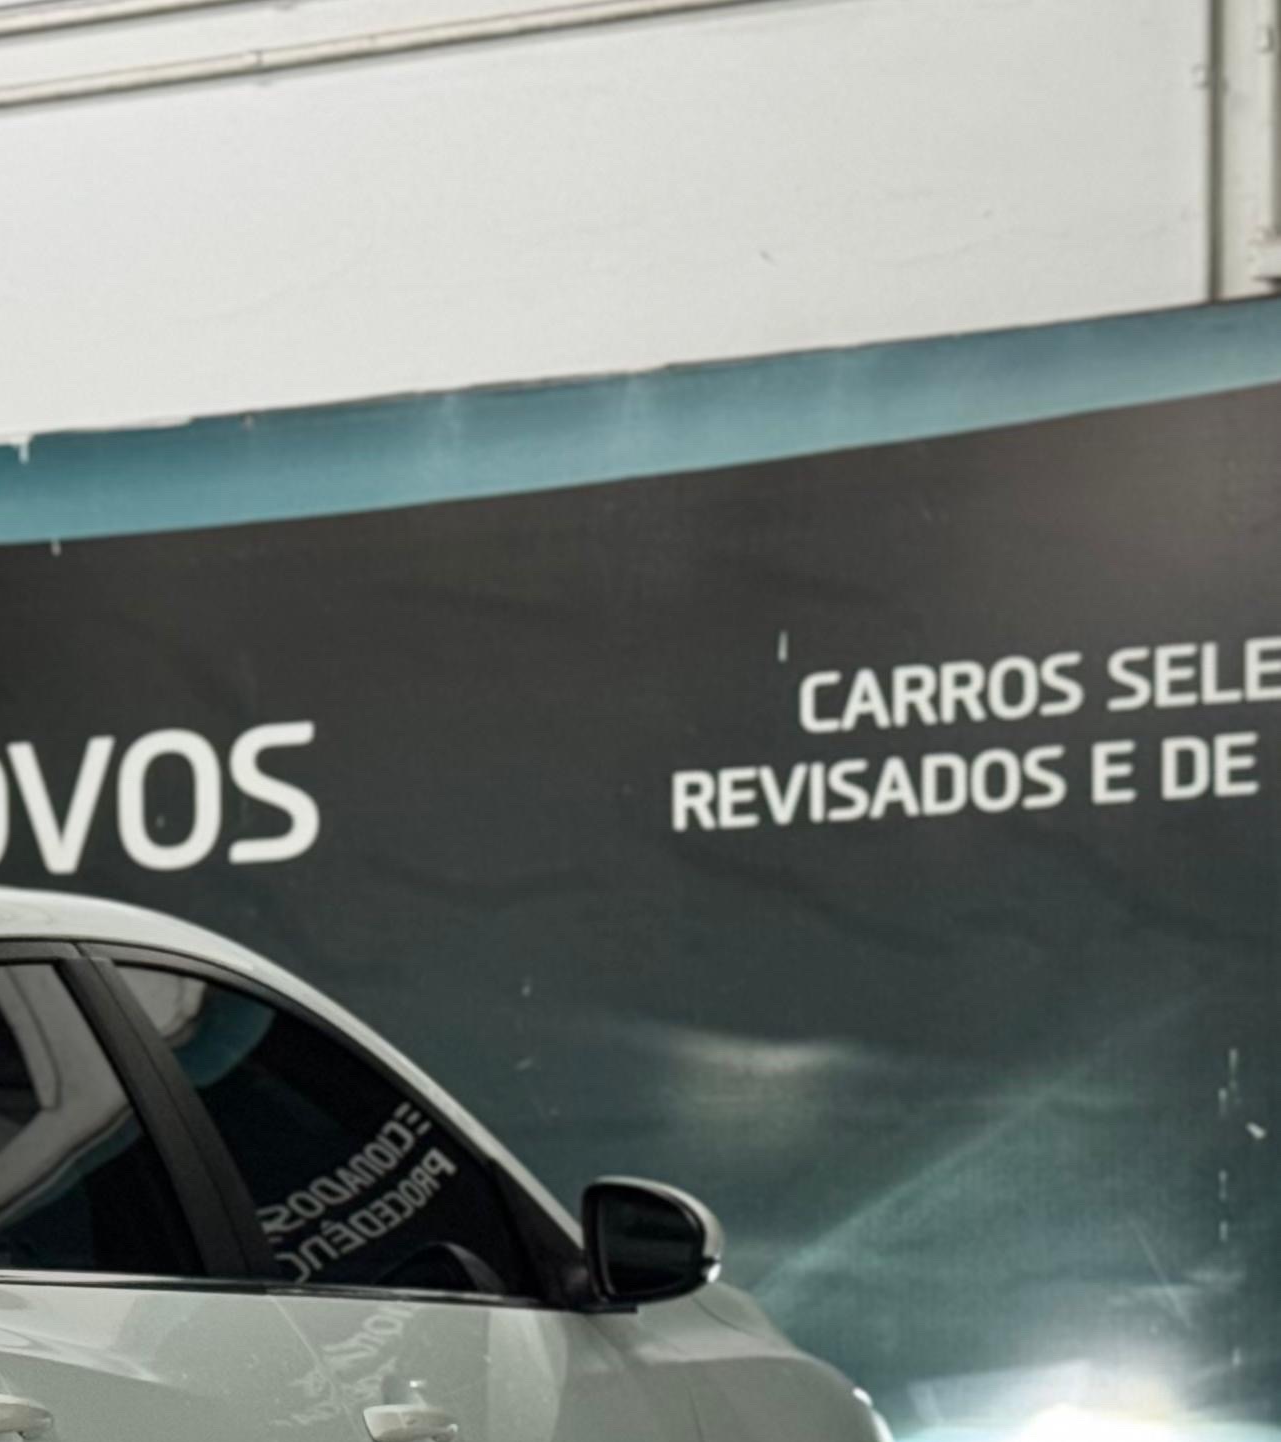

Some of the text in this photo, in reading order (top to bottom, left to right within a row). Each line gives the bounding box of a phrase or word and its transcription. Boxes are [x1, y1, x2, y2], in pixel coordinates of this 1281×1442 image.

[799, 636, 1281, 734] CARROS SELE
[671, 731, 1259, 832] REVISADOS E DE
